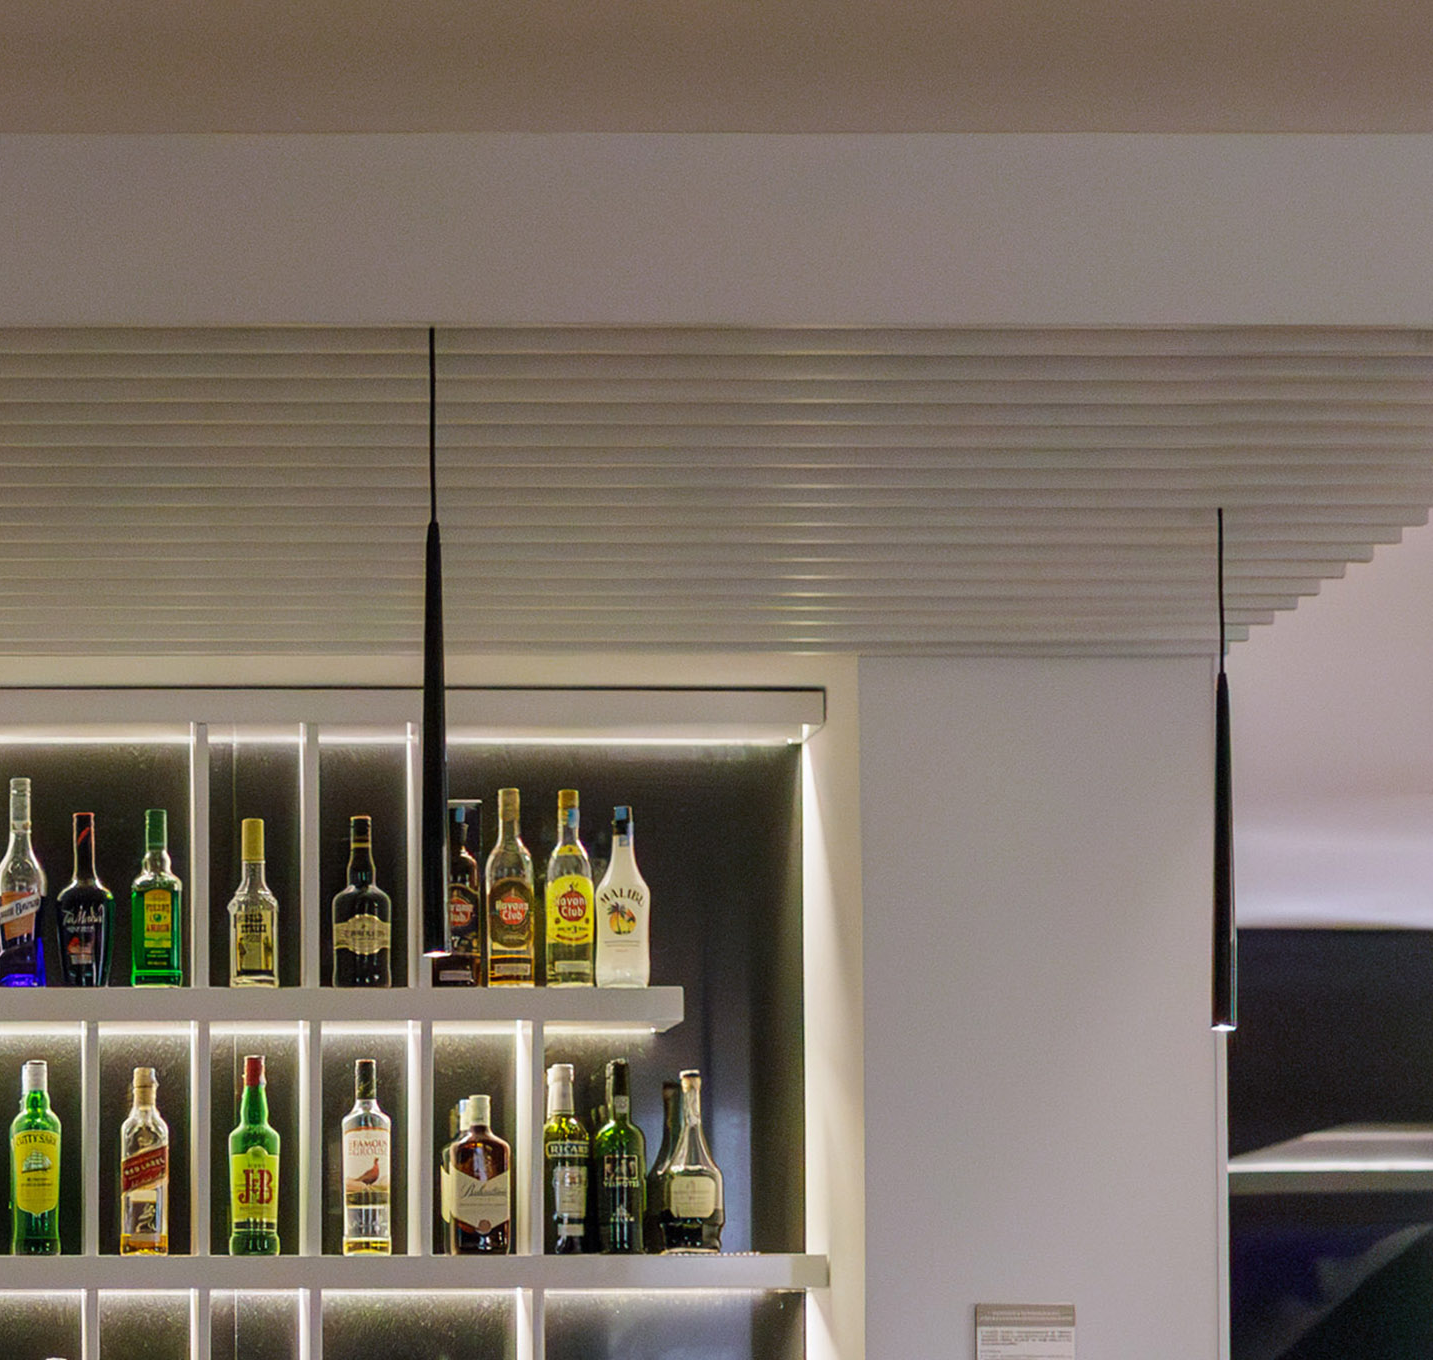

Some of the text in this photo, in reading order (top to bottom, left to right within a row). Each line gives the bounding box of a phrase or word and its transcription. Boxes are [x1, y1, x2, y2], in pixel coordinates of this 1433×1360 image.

[501, 910, 523, 920] Club
[561, 906, 583, 917] Club
[238, 1169, 273, 1204] J&B
